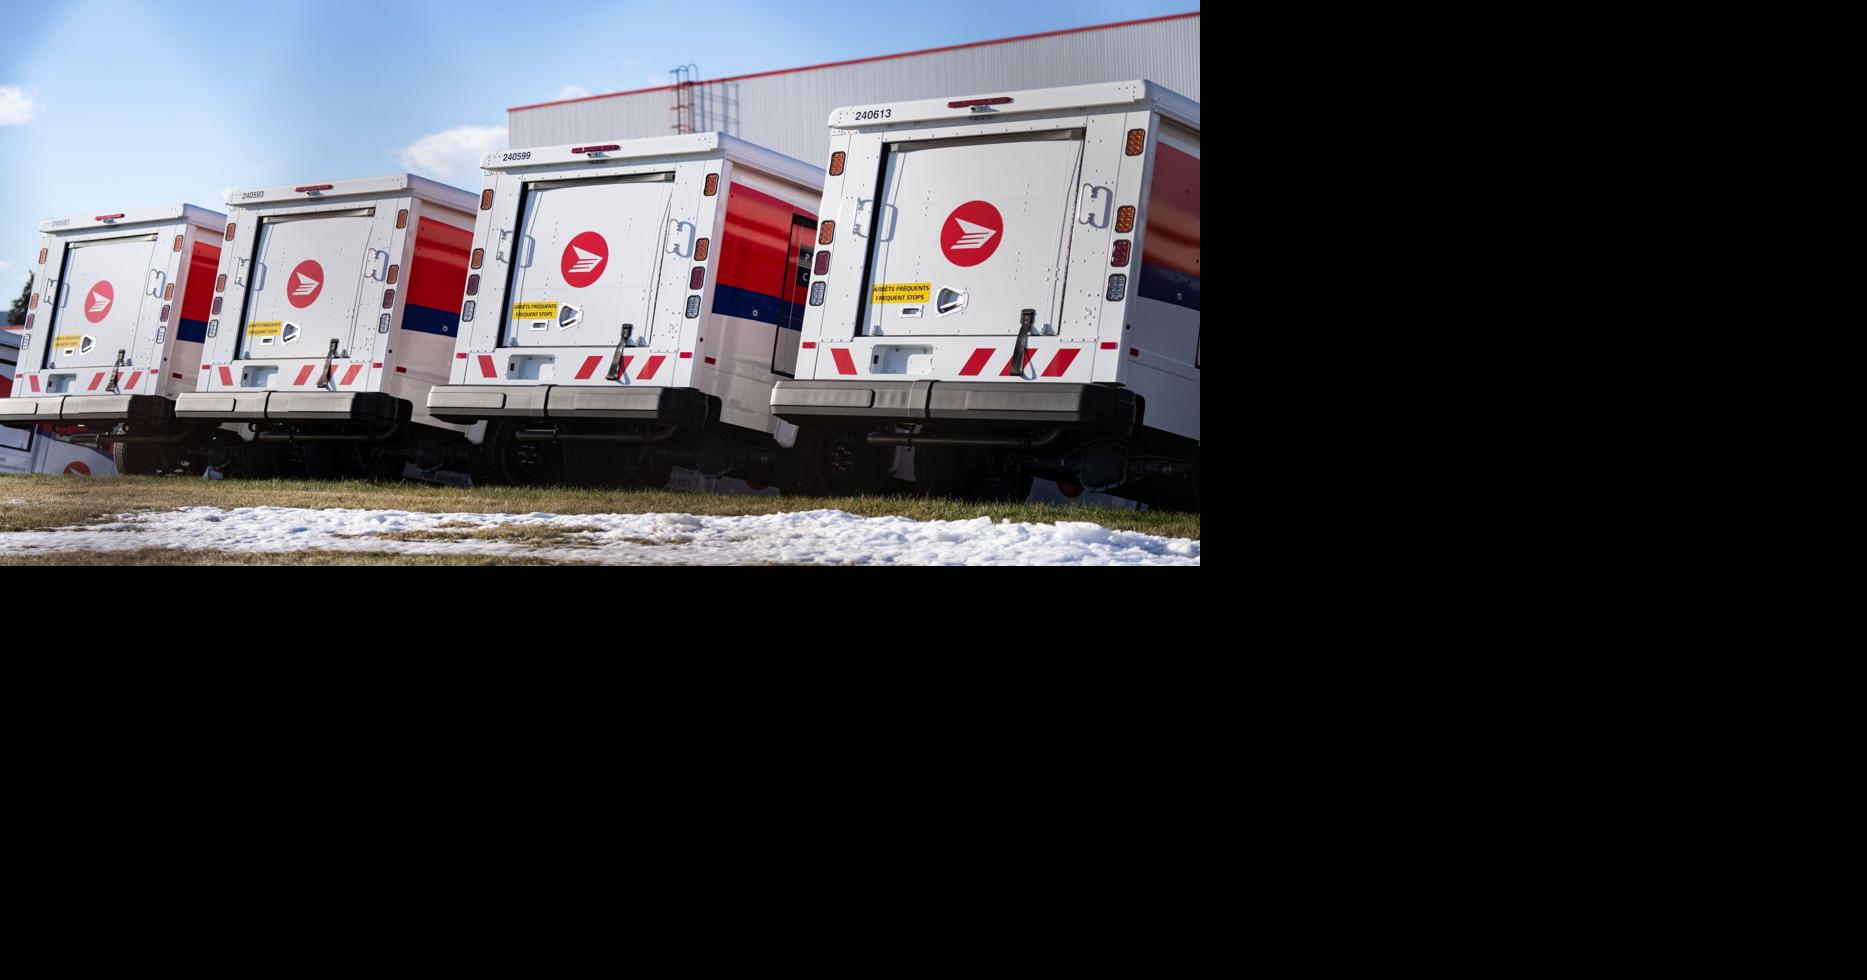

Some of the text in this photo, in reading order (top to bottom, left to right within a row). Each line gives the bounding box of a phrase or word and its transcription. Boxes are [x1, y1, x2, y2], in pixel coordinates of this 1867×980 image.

[855, 108, 892, 120] 240613
[502, 151, 531, 161] 240599
[241, 190, 265, 199] 240593
[805, 253, 811, 261] P
[802, 272, 808, 281] C
[896, 284, 930, 292] FRÉQUENTS
